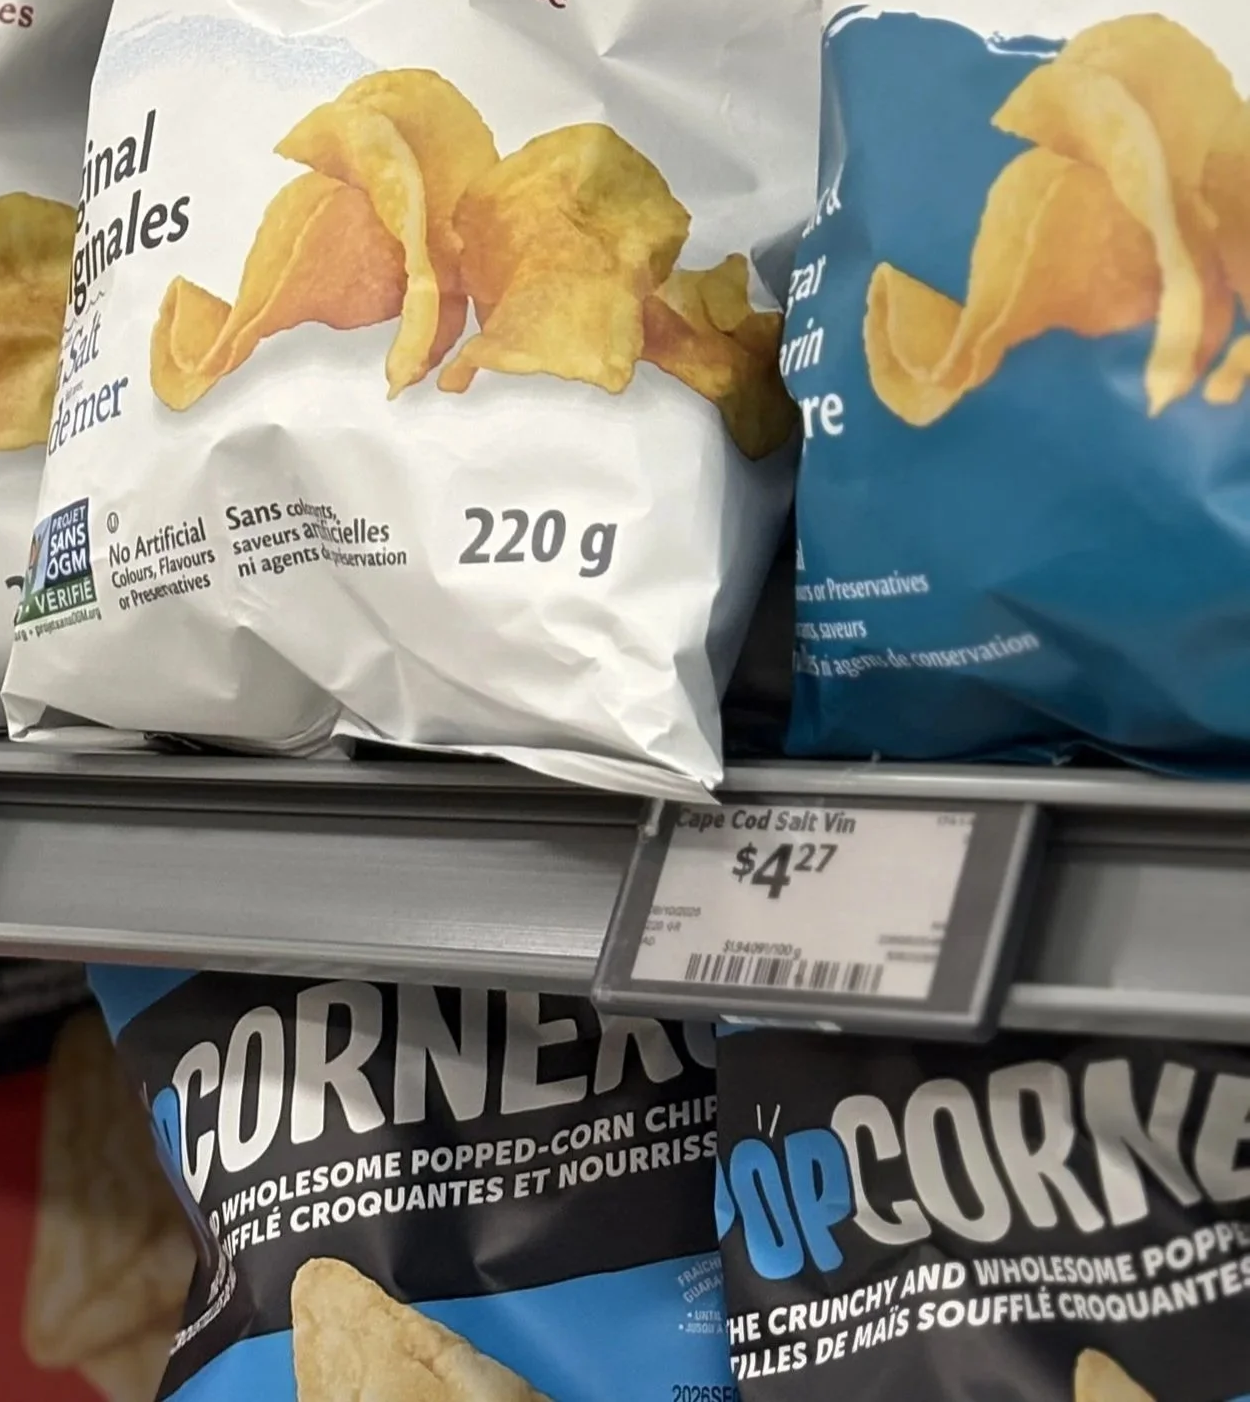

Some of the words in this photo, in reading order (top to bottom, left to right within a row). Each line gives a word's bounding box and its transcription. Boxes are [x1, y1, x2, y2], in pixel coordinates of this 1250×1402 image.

[71, 375, 128, 439] mer
[51, 505, 86, 533] PROJET
[225, 501, 283, 531] Sans
[50, 522, 86, 556] SANS
[108, 544, 131, 567] No
[134, 516, 207, 559] Artificial
[232, 526, 301, 555] saveurs
[458, 507, 567, 565] 220
[578, 522, 618, 578] g
[46, 548, 87, 580] OGM
[112, 564, 158, 589] Colours,
[158, 547, 216, 576] Flavours
[238, 557, 257, 578] ni
[261, 545, 320, 575] agents
[35, 576, 93, 614] VÉRIFIÉ
[119, 595, 131, 611] or
[131, 571, 211, 608] Preservatives
[814, 585, 826, 600] or
[826, 570, 929, 600] Preservatives
[820, 620, 867, 640] saveurs
[886, 647, 911, 669] de
[911, 631, 1040, 668] conservation
[676, 808, 725, 833] Cape
[731, 809, 769, 831] Cod
[774, 810, 820, 834] Salt
[823, 811, 857, 834] Vin
[221, 1152, 401, 1226] WHOLESOME
[411, 1112, 634, 1175] POPPED-CORN
[289, 1176, 504, 1233] CROQUANTES
[513, 1168, 551, 1198] ET
[558, 1131, 717, 1189] NOURRISS
[726, 1312, 762, 1346] HE
[767, 1275, 898, 1336] CRUNCHY
[900, 1261, 966, 1299] AND
[973, 1254, 1137, 1286] WHOLESOME
[814, 1331, 849, 1366] DE
[851, 1304, 910, 1354] MAÏS
[916, 1286, 1055, 1332] SOUFFLÉ
